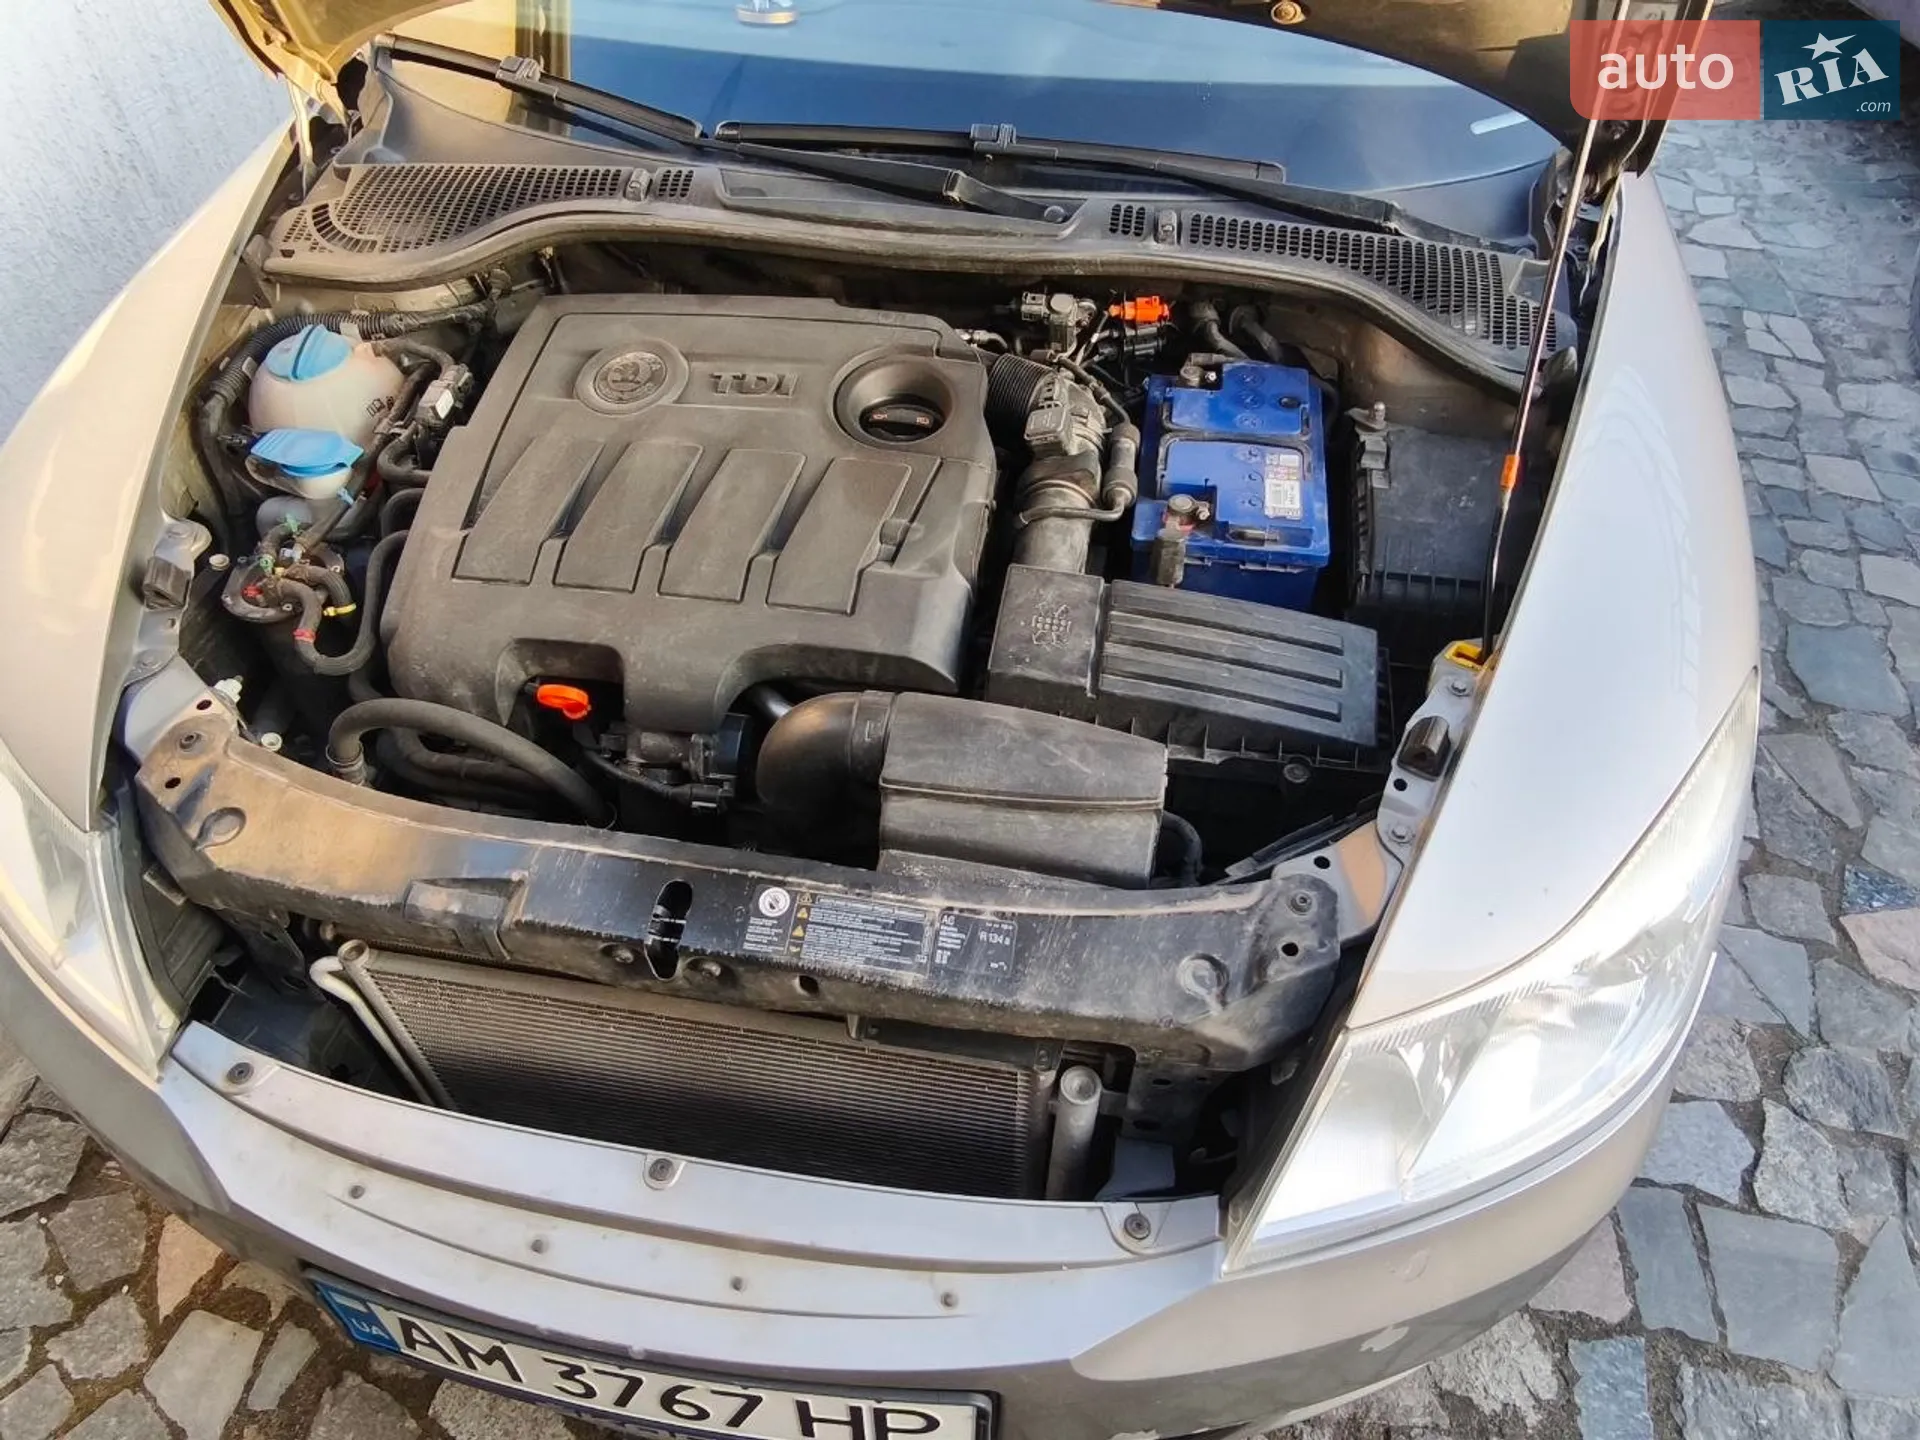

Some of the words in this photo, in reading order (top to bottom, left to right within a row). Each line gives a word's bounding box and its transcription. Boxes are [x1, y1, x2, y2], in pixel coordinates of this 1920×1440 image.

[709, 372, 797, 398] TDI
[351, 1318, 390, 1341] UA
[398, 1317, 524, 1384] AM
[542, 1357, 764, 1428] 3767
[796, 1399, 941, 1440] HP
